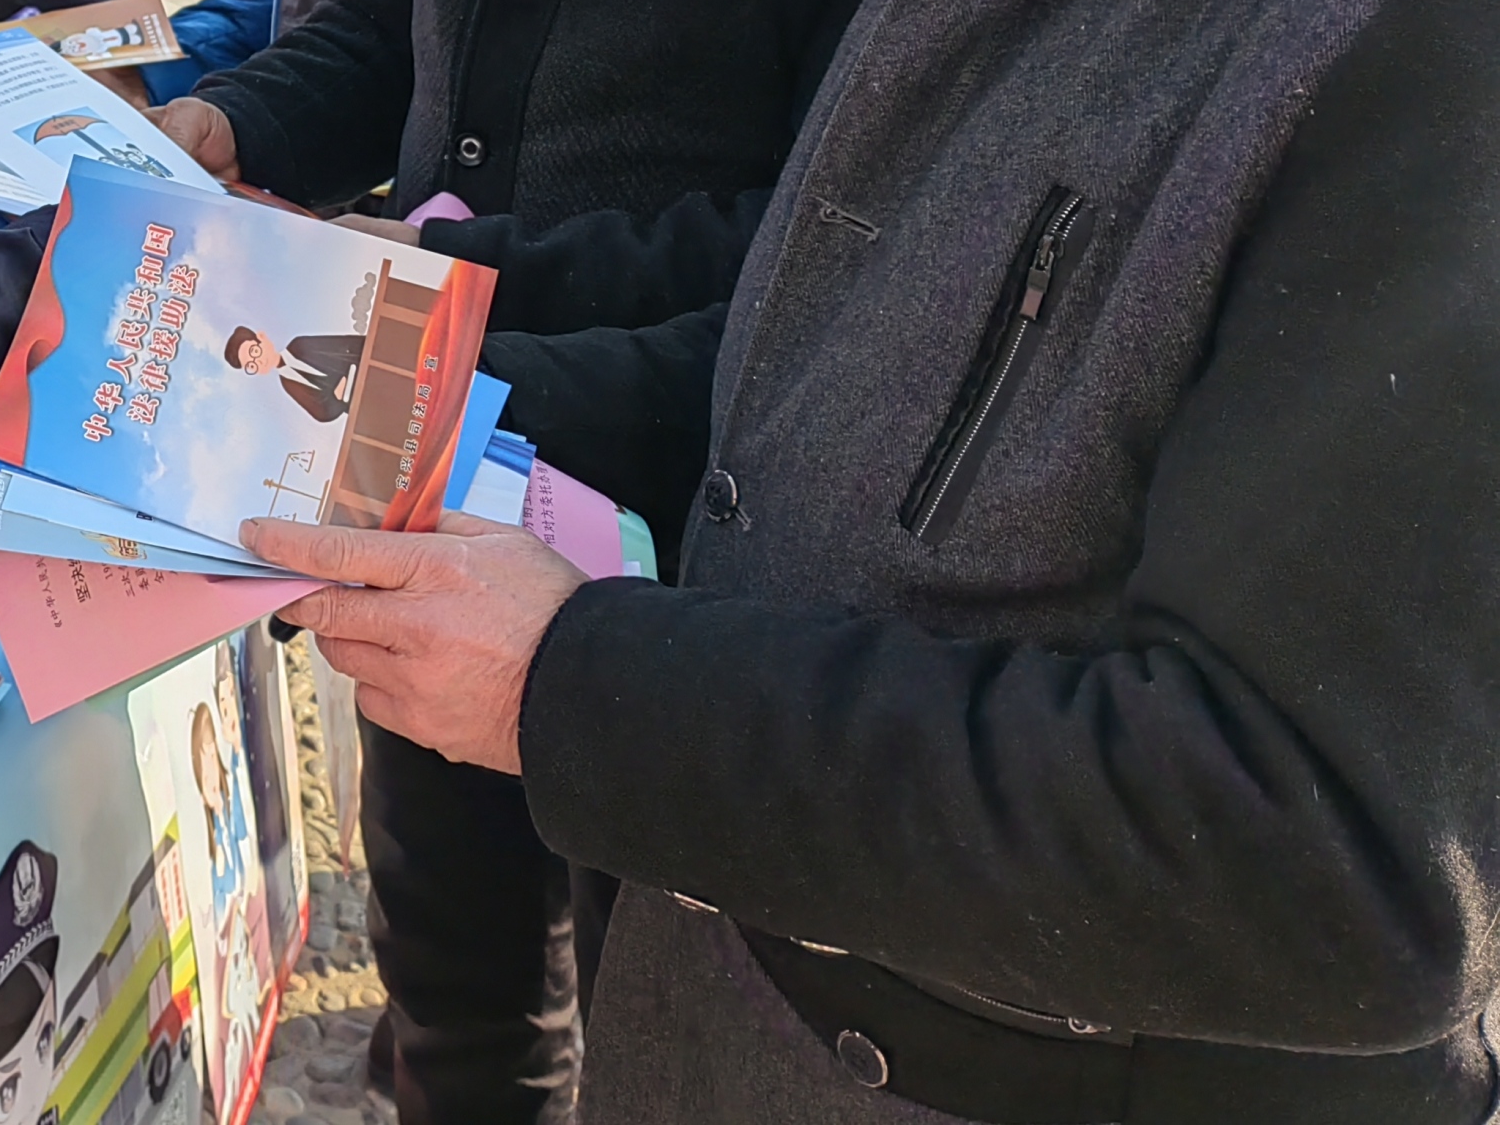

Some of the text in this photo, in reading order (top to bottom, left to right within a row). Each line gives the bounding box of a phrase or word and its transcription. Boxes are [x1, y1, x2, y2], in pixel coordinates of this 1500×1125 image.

[82, 223, 174, 442] 中华人民共和国
[127, 264, 197, 425] 法律援助法
[395, 383, 432, 491] 定兴县司法局
